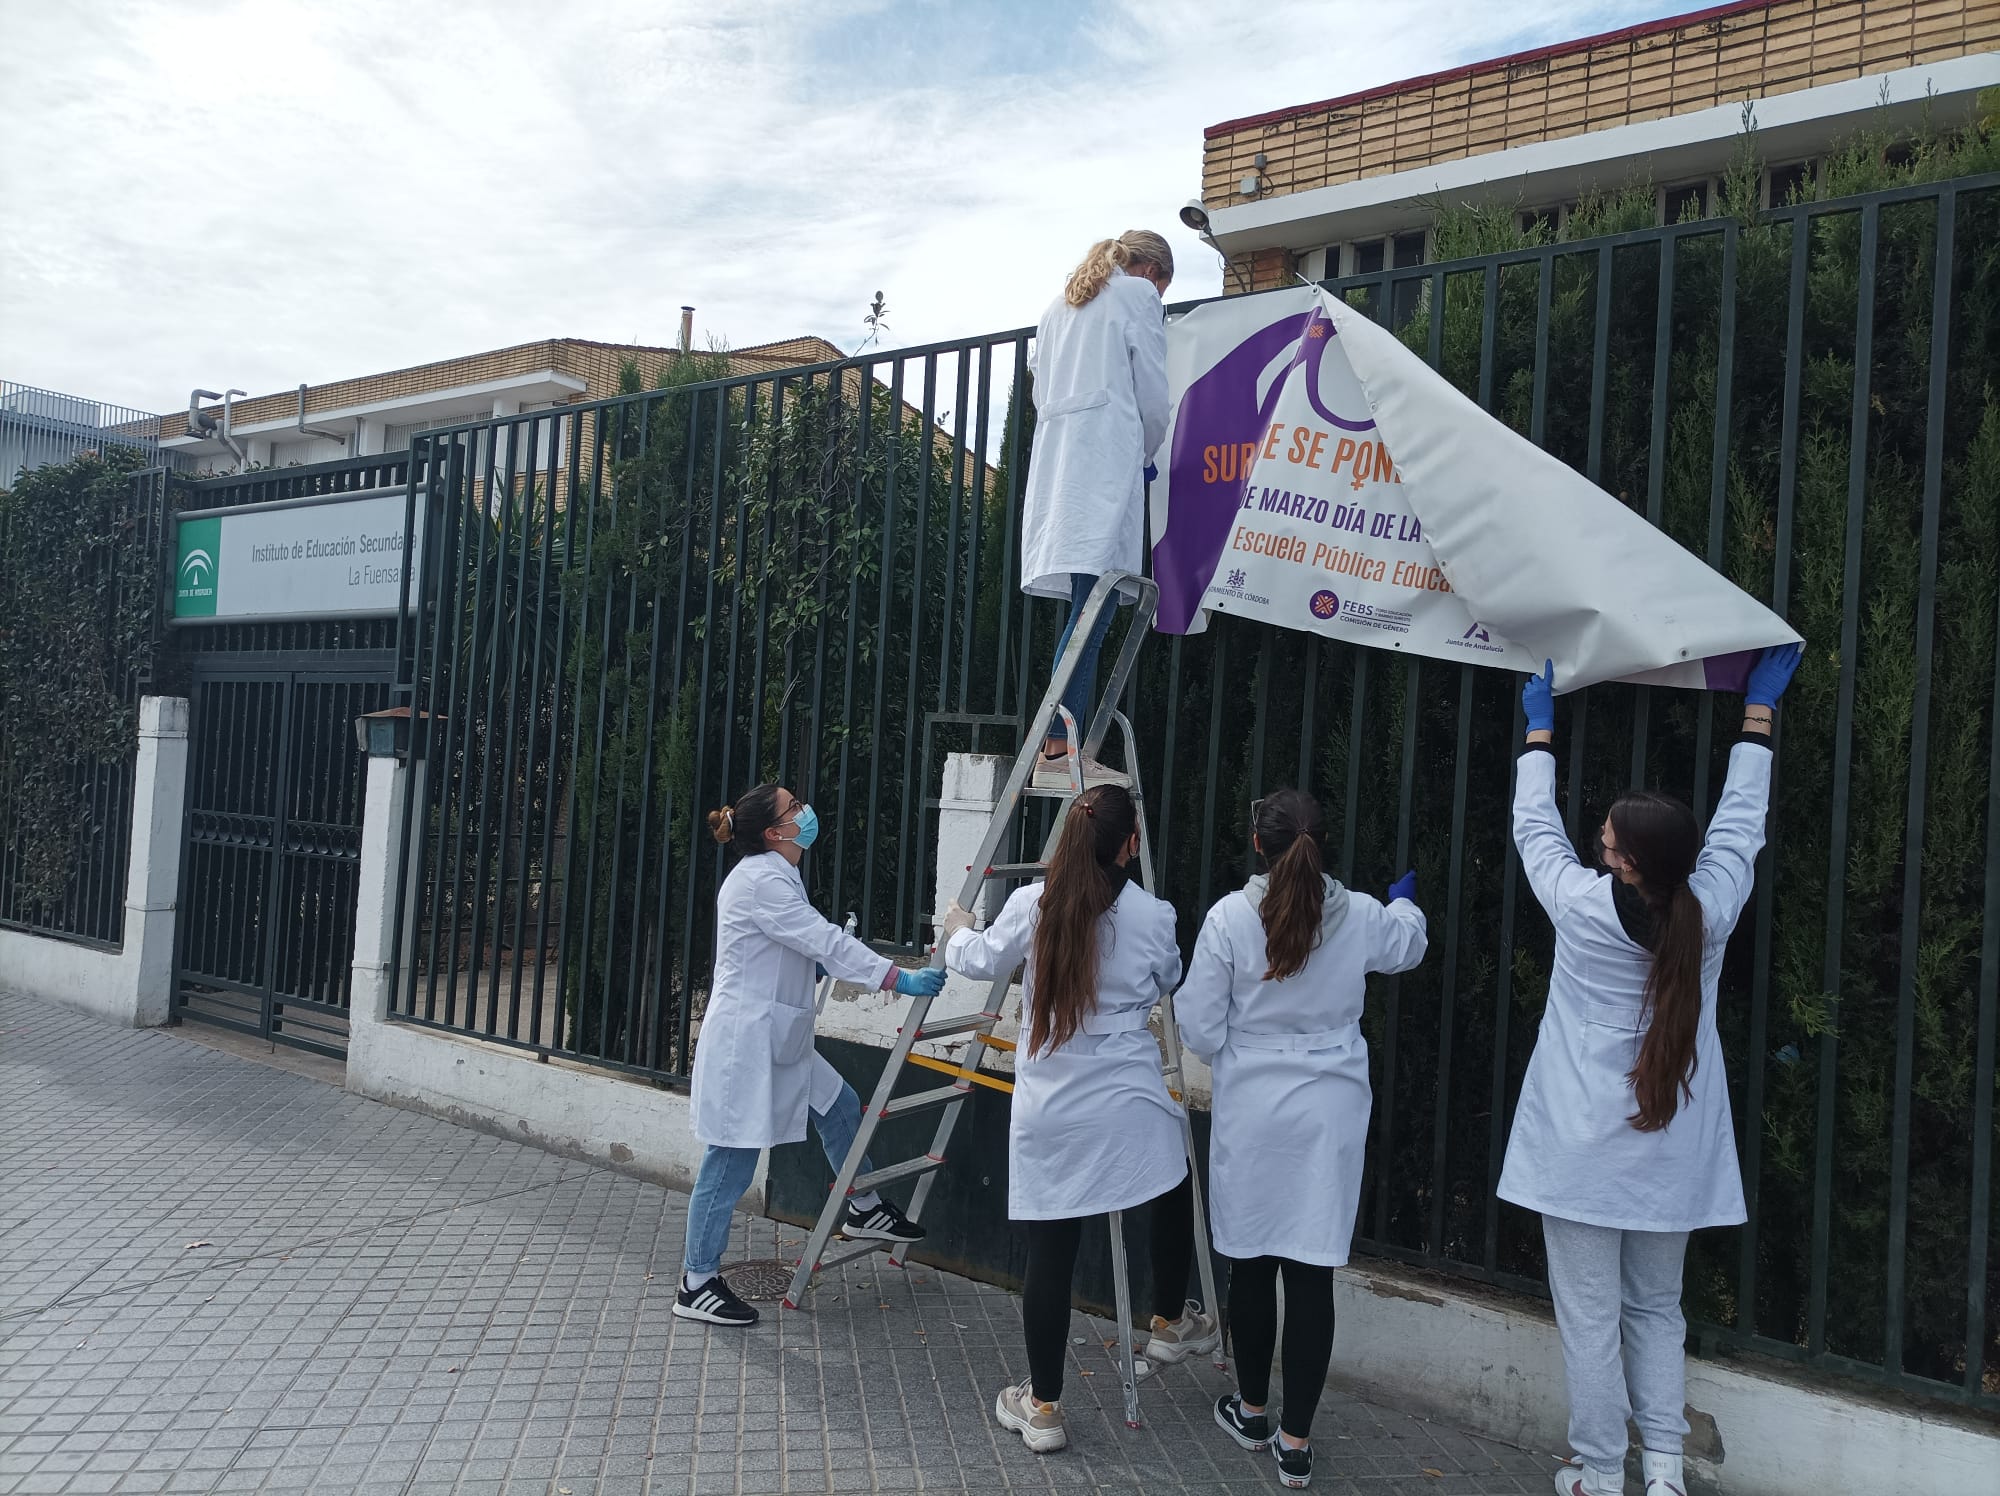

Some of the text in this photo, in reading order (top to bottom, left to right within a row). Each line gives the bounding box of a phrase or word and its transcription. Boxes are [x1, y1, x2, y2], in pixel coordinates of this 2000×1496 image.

[1287, 426, 1329, 469] SE
[1330, 437, 1402, 491] PON
[1258, 487, 1329, 524] MARZO
[1331, 501, 1367, 535] DÍA
[1370, 512, 1397, 540] DE
[1398, 515, 1423, 543] LA
[252, 543, 289, 563] Instituto
[291, 541, 303, 560] de
[306, 536, 355, 559] Educación
[1232, 525, 1456, 594] Escuela Pública Educa
[348, 565, 360, 586] La
[1236, 590, 1245, 600] DE
[1342, 600, 1374, 616] FEBS
[1340, 615, 1409, 634] COMISIÓN DE GÉNERO
[1445, 638, 1464, 646] Junta
[1473, 642, 1504, 653] Andalucía
